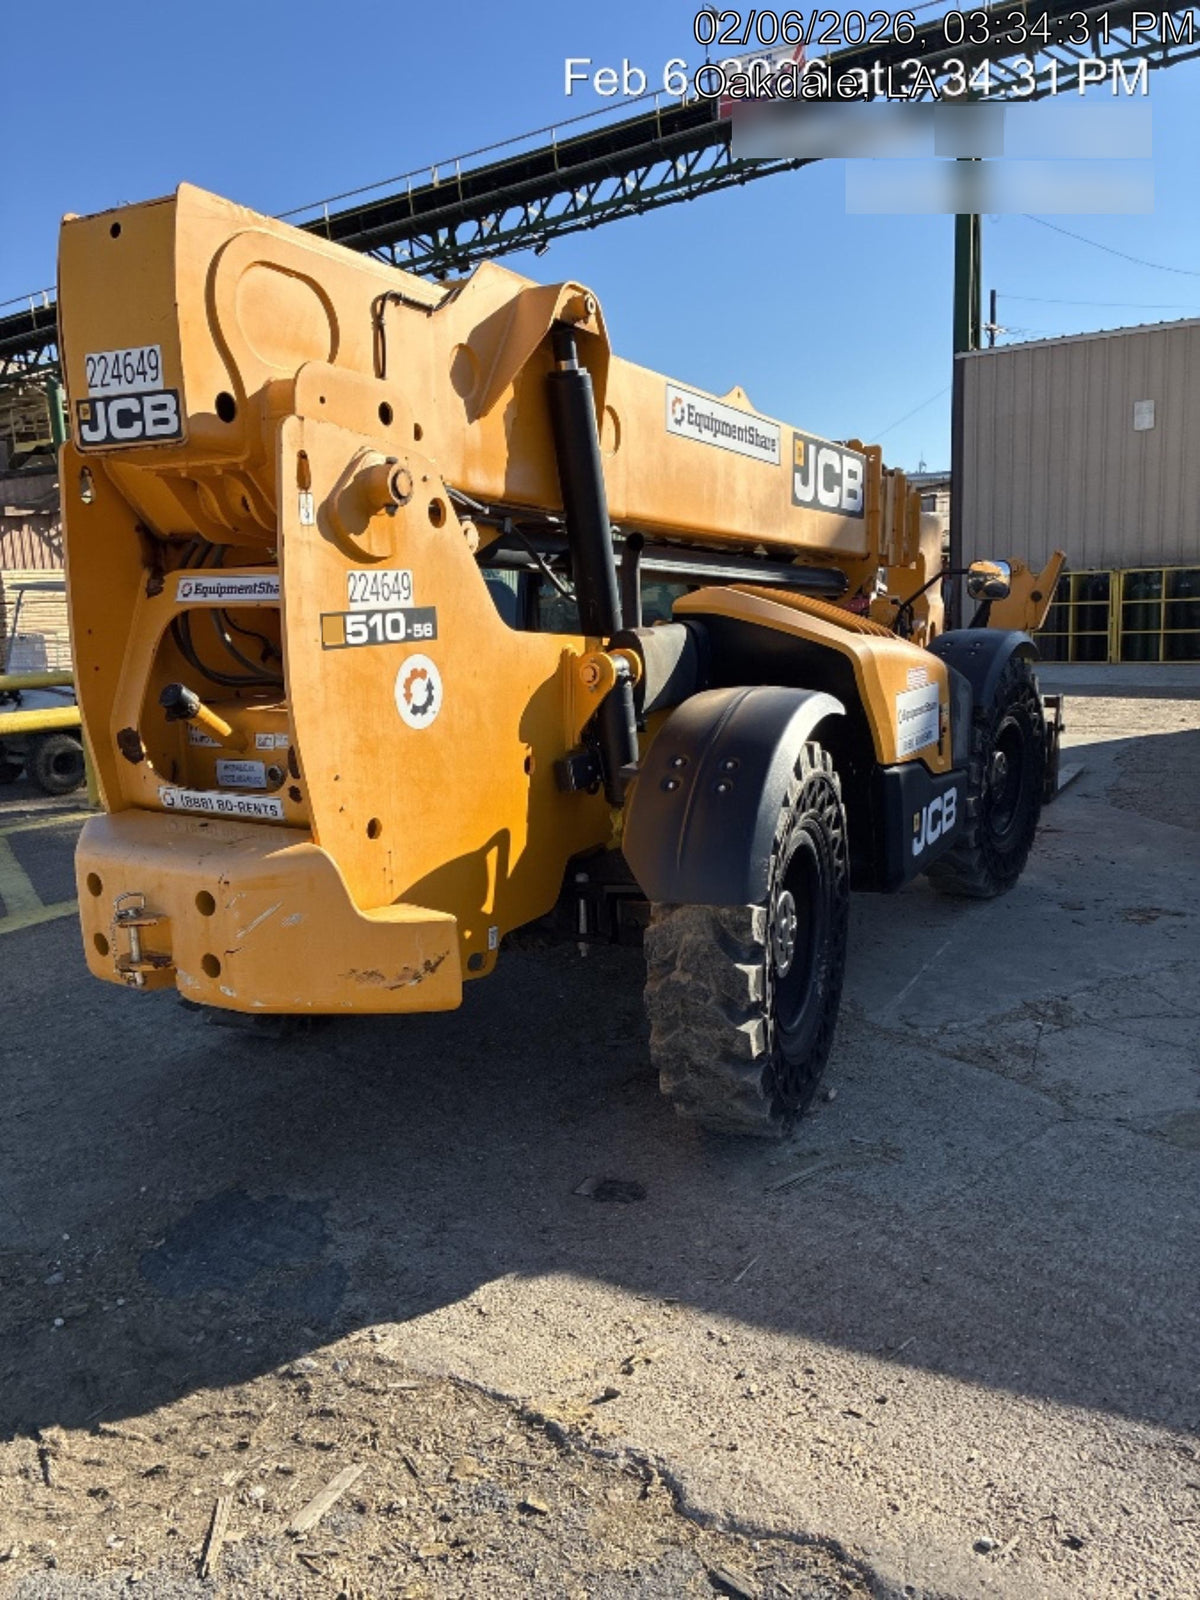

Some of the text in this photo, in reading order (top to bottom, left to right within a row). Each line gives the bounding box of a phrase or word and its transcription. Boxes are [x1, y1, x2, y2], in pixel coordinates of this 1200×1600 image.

[86, 348, 158, 388] 224649
[81, 394, 178, 442] JCB
[687, 403, 777, 453] EquipmentShare
[794, 443, 864, 513] JCB
[348, 572, 411, 603] 224649
[912, 786, 957, 856] JCB
